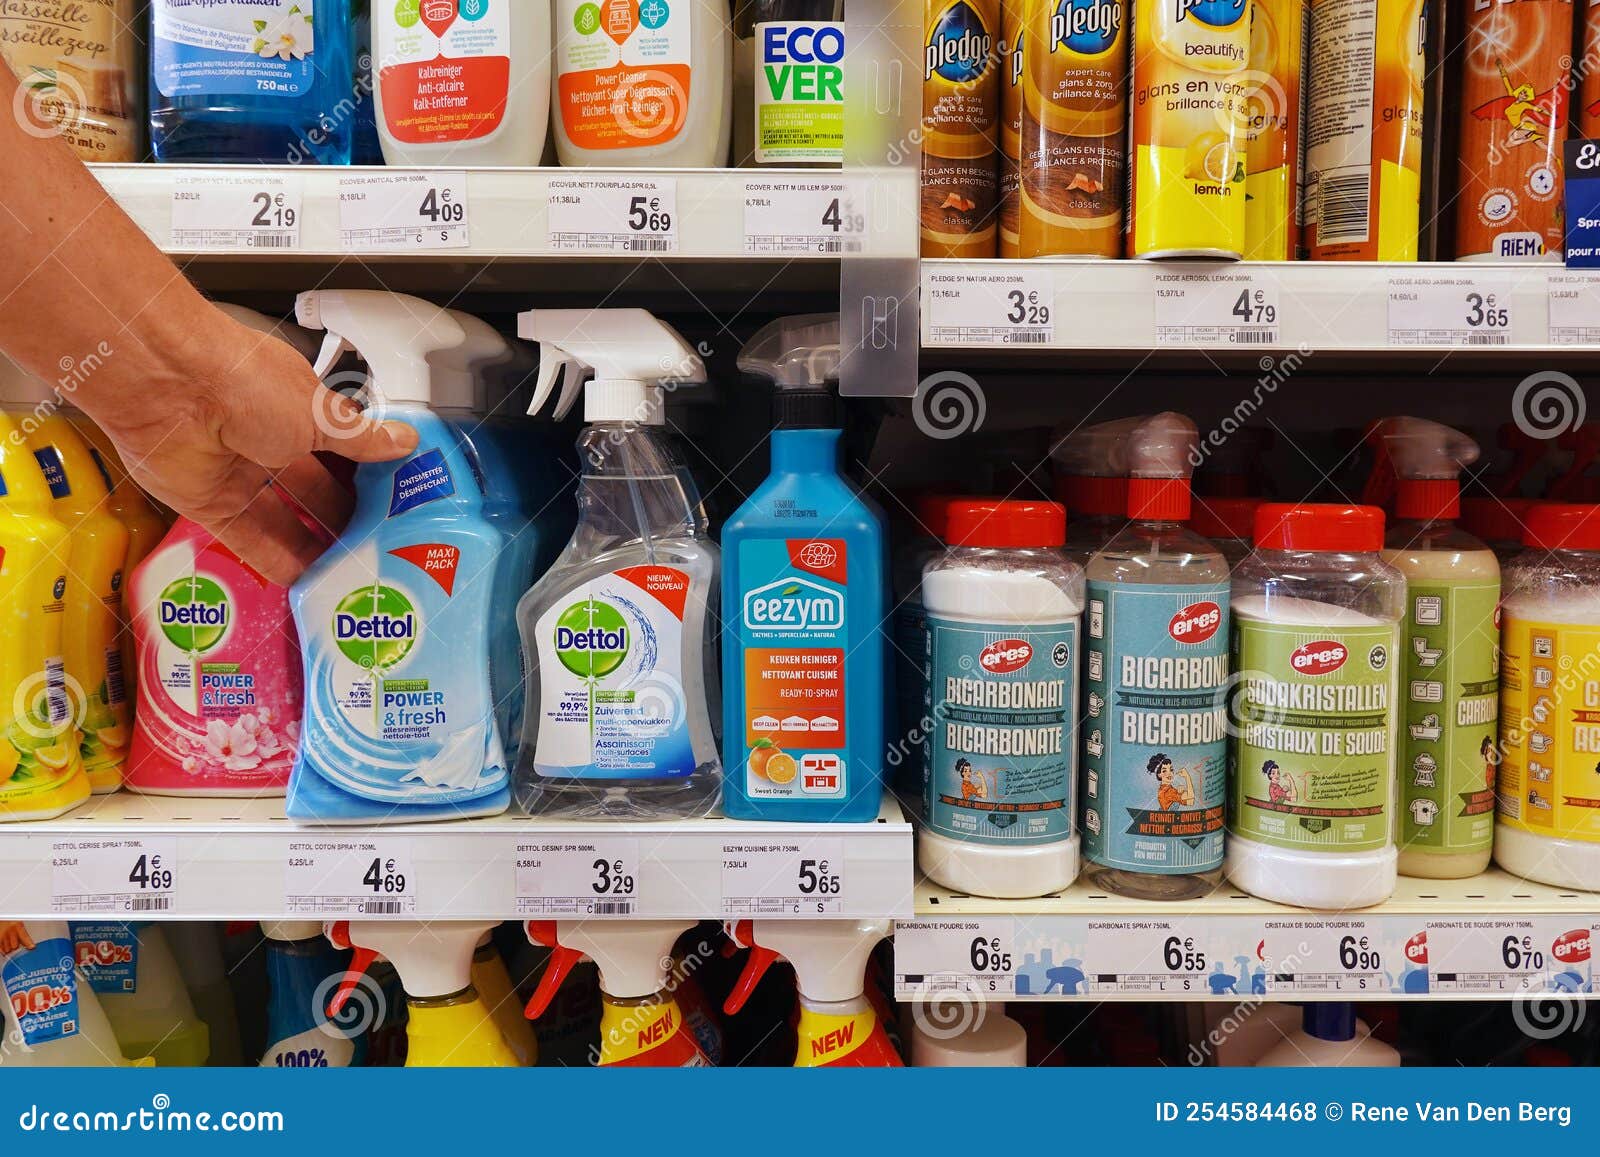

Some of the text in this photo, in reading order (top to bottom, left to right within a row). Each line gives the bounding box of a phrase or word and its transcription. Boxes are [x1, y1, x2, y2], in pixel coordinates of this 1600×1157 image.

[1050, 1, 1121, 54] pledge
[764, 27, 845, 63] ECO
[925, 29, 992, 82] pledge
[1184, 43, 1239, 60] beautify
[595, 73, 618, 86] Power
[1065, 69, 1094, 78] expert
[257, 80, 276, 90] 750
[418, 80, 465, 94] Anti-calcaire
[764, 65, 844, 101] VER
[1059, 79, 1113, 90] glans & zorg
[571, 87, 628, 105] Nettoyant Super
[1053, 90, 1092, 100] brillance
[1138, 80, 1208, 105] glans en
[413, 95, 468, 111] Kalk-Entferner
[1166, 98, 1224, 111] brillance
[1052, 146, 1096, 155] GLANS EN
[928, 167, 955, 175] GLANS
[1194, 183, 1231, 196] lemon
[1068, 200, 1101, 209] classic
[943, 217, 972, 226] classic
[1567, 248, 1594, 259] pour
[427, 547, 455, 559] MAXI
[425, 559, 455, 570] PACK
[806, 555, 833, 565] CERT
[647, 582, 683, 590] NOUVEAU
[161, 601, 226, 625] Dettol
[753, 598, 834, 628] eezym
[337, 614, 413, 639] Dettol
[1172, 608, 1219, 636] eres
[556, 627, 625, 650] Dettol
[769, 655, 838, 665] KEUKEN REINIGER
[983, 643, 1031, 666] eres
[1293, 647, 1344, 668] eres
[762, 670, 838, 679] NETTOYANT CUISINE
[202, 675, 253, 688] POWER
[203, 689, 255, 705] & fresh
[780, 688, 838, 698] READY-TO-SPRAY
[946, 676, 1065, 709] BICARBONAAT
[1246, 678, 1387, 713] SODAKRISTALLEN
[384, 691, 444, 708] POWER
[559, 702, 588, 712] 99,9%
[595, 706, 644, 716] Zuiverend
[383, 706, 446, 726] & fresh
[595, 718, 671, 727] multi-oppervlakken
[383, 726, 430, 735] allesreiniger
[383, 732, 430, 740] nettoie-tout
[595, 739, 655, 749] Assainissant
[946, 722, 1062, 756] BICARBONATE
[1245, 723, 1386, 756] CRISTAUX DE SOUDE
[595, 748, 649, 756] multi-surfaces
[102, 841, 122, 849] SPRAY
[722, 845, 743, 853] EEZYM
[895, 922, 980, 930] BICARBONATE POUDRE 950G
[1088, 922, 1152, 930] BICARBONATE SPRAY
[1325, 921, 1351, 929] POUDRE
[1426, 921, 1515, 929] CARBONATE DE SOUDE SPRAY
[637, 1007, 674, 1050] NEW
[811, 1020, 857, 1058] NEW
